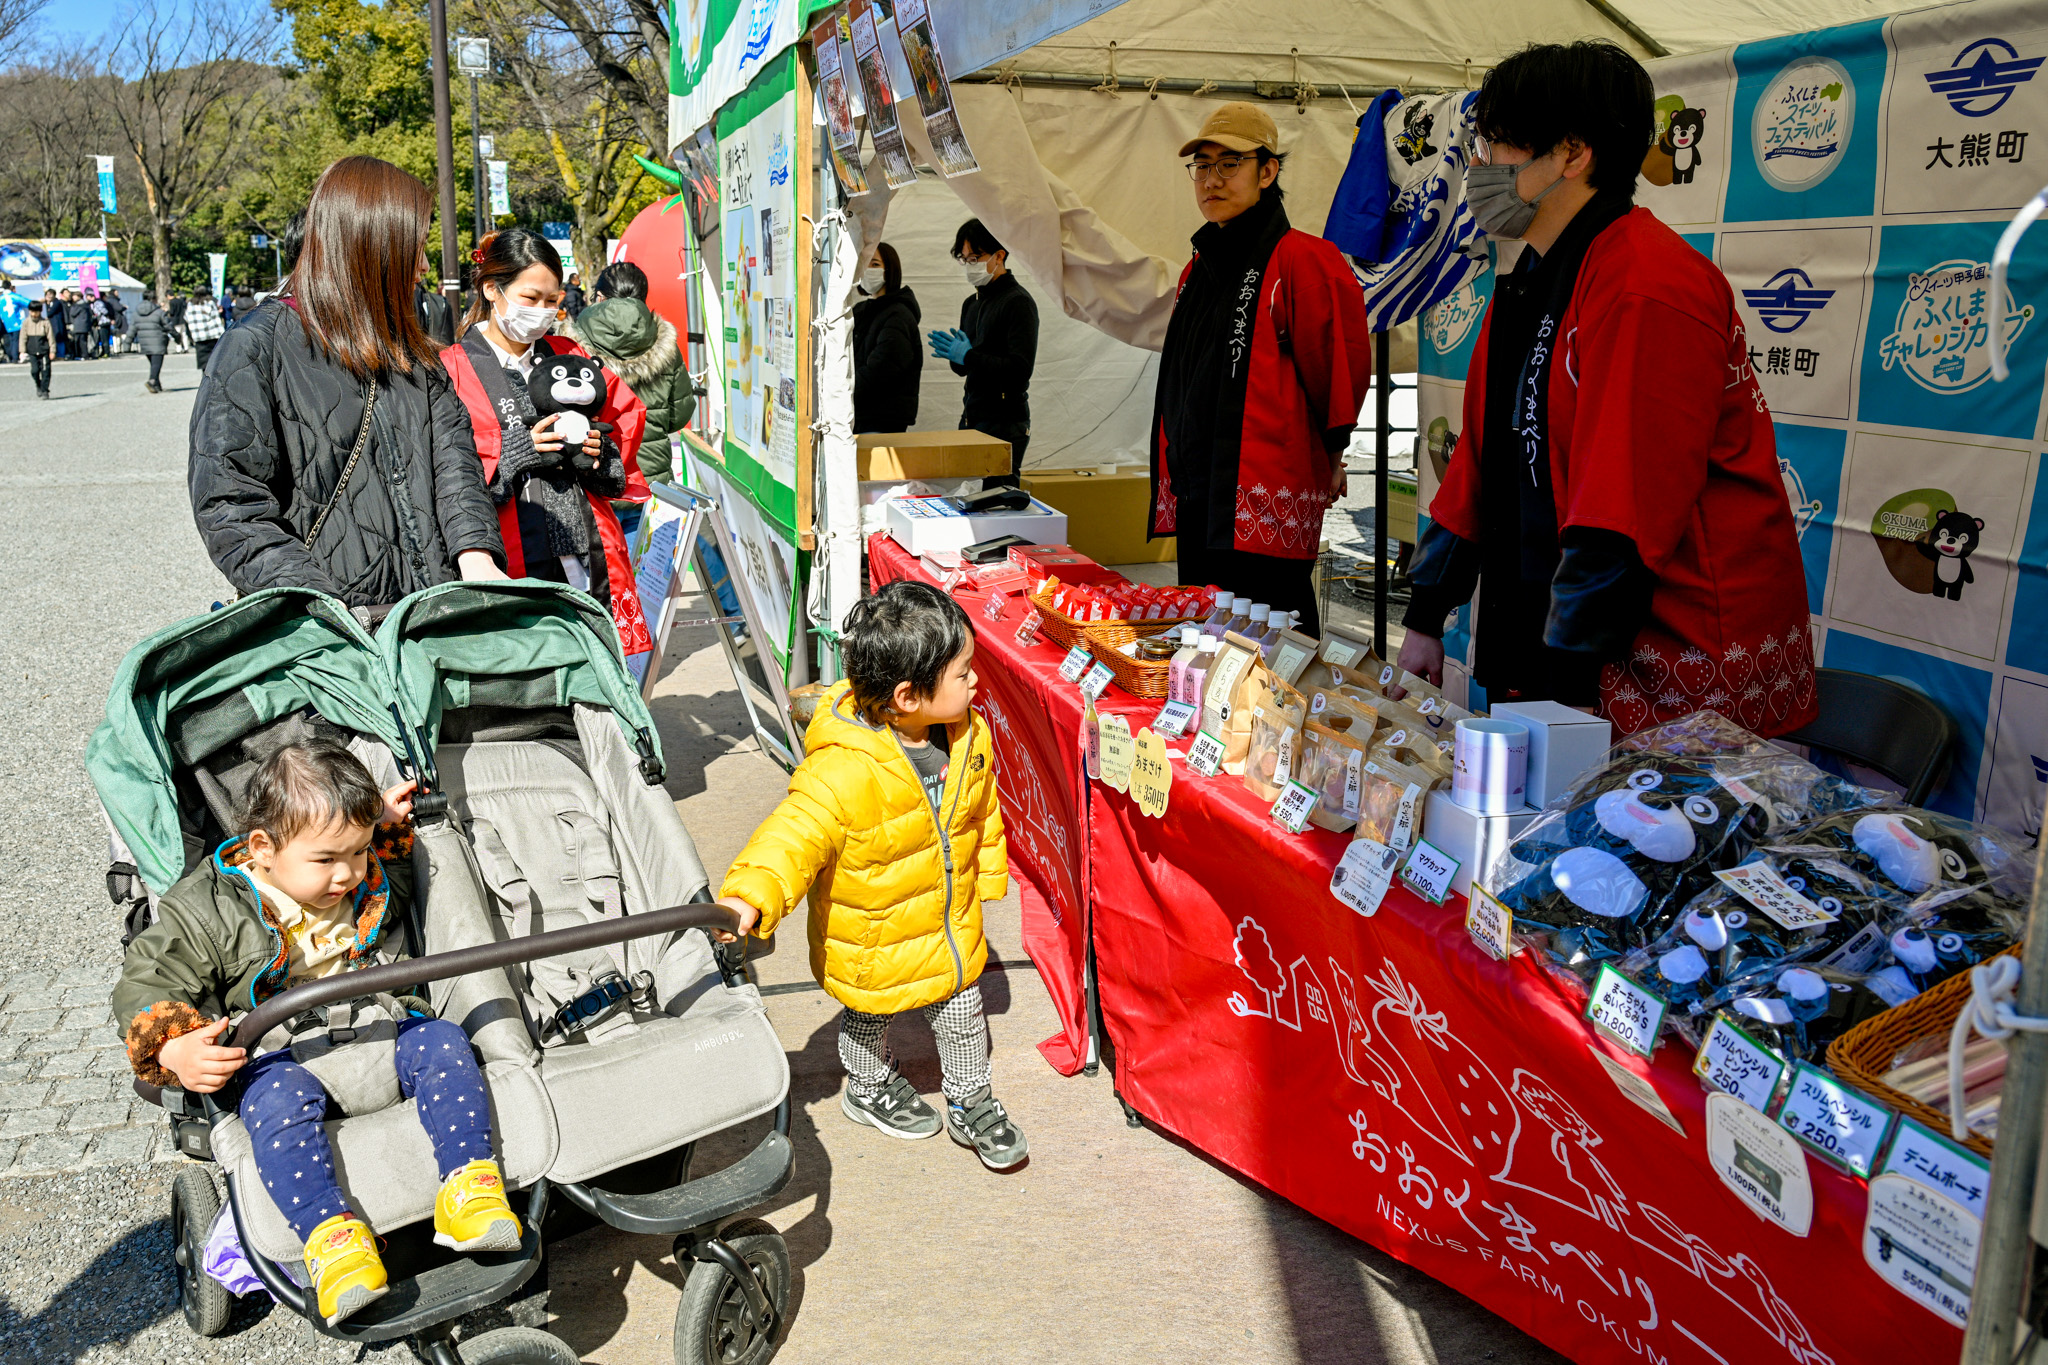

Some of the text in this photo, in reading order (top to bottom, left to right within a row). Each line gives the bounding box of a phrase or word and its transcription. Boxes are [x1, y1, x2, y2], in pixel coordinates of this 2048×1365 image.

[1781, 85, 1819, 105] ふくしま
[1765, 110, 1837, 147] フェスティバル
[1779, 101, 1823, 126] スイーツ
[1926, 131, 2029, 171] 大熊町
[1910, 265, 1986, 301] スイーツ甲子園
[1913, 288, 1986, 331] ふくしま
[1883, 312, 2025, 368] チャレンジカプ
[1747, 345, 1820, 378] 大熊町
[1880, 512, 1928, 531] OKUMA
[1882, 525, 1920, 543] KIWI
[1135, 755, 1162, 779] あまざけ
[1143, 783, 1165, 812] 350円
[1418, 852, 1447, 877] マグカップ
[1480, 899, 1500, 923] まーちゃん
[1602, 992, 1649, 1030] ぬいぐるみ S
[1611, 982, 1648, 1014] まーちゃん
[693, 1029, 740, 1055] AIRBUGGY
[1713, 1029, 1770, 1080] スリムペンシル
[1723, 1055, 1750, 1080] ピンク
[1713, 1067, 1746, 1101] 250円
[878, 1093, 898, 1112] N
[1800, 1081, 1873, 1130] スリムペンシル
[1816, 1106, 1848, 1132] ブルー
[1802, 1121, 1846, 1157] 250円
[1727, 1166, 1787, 1222] 1,100円(税込)
[1376, 1193, 1469, 1254] NEXUS
[1478, 1246, 1566, 1304] FARM
